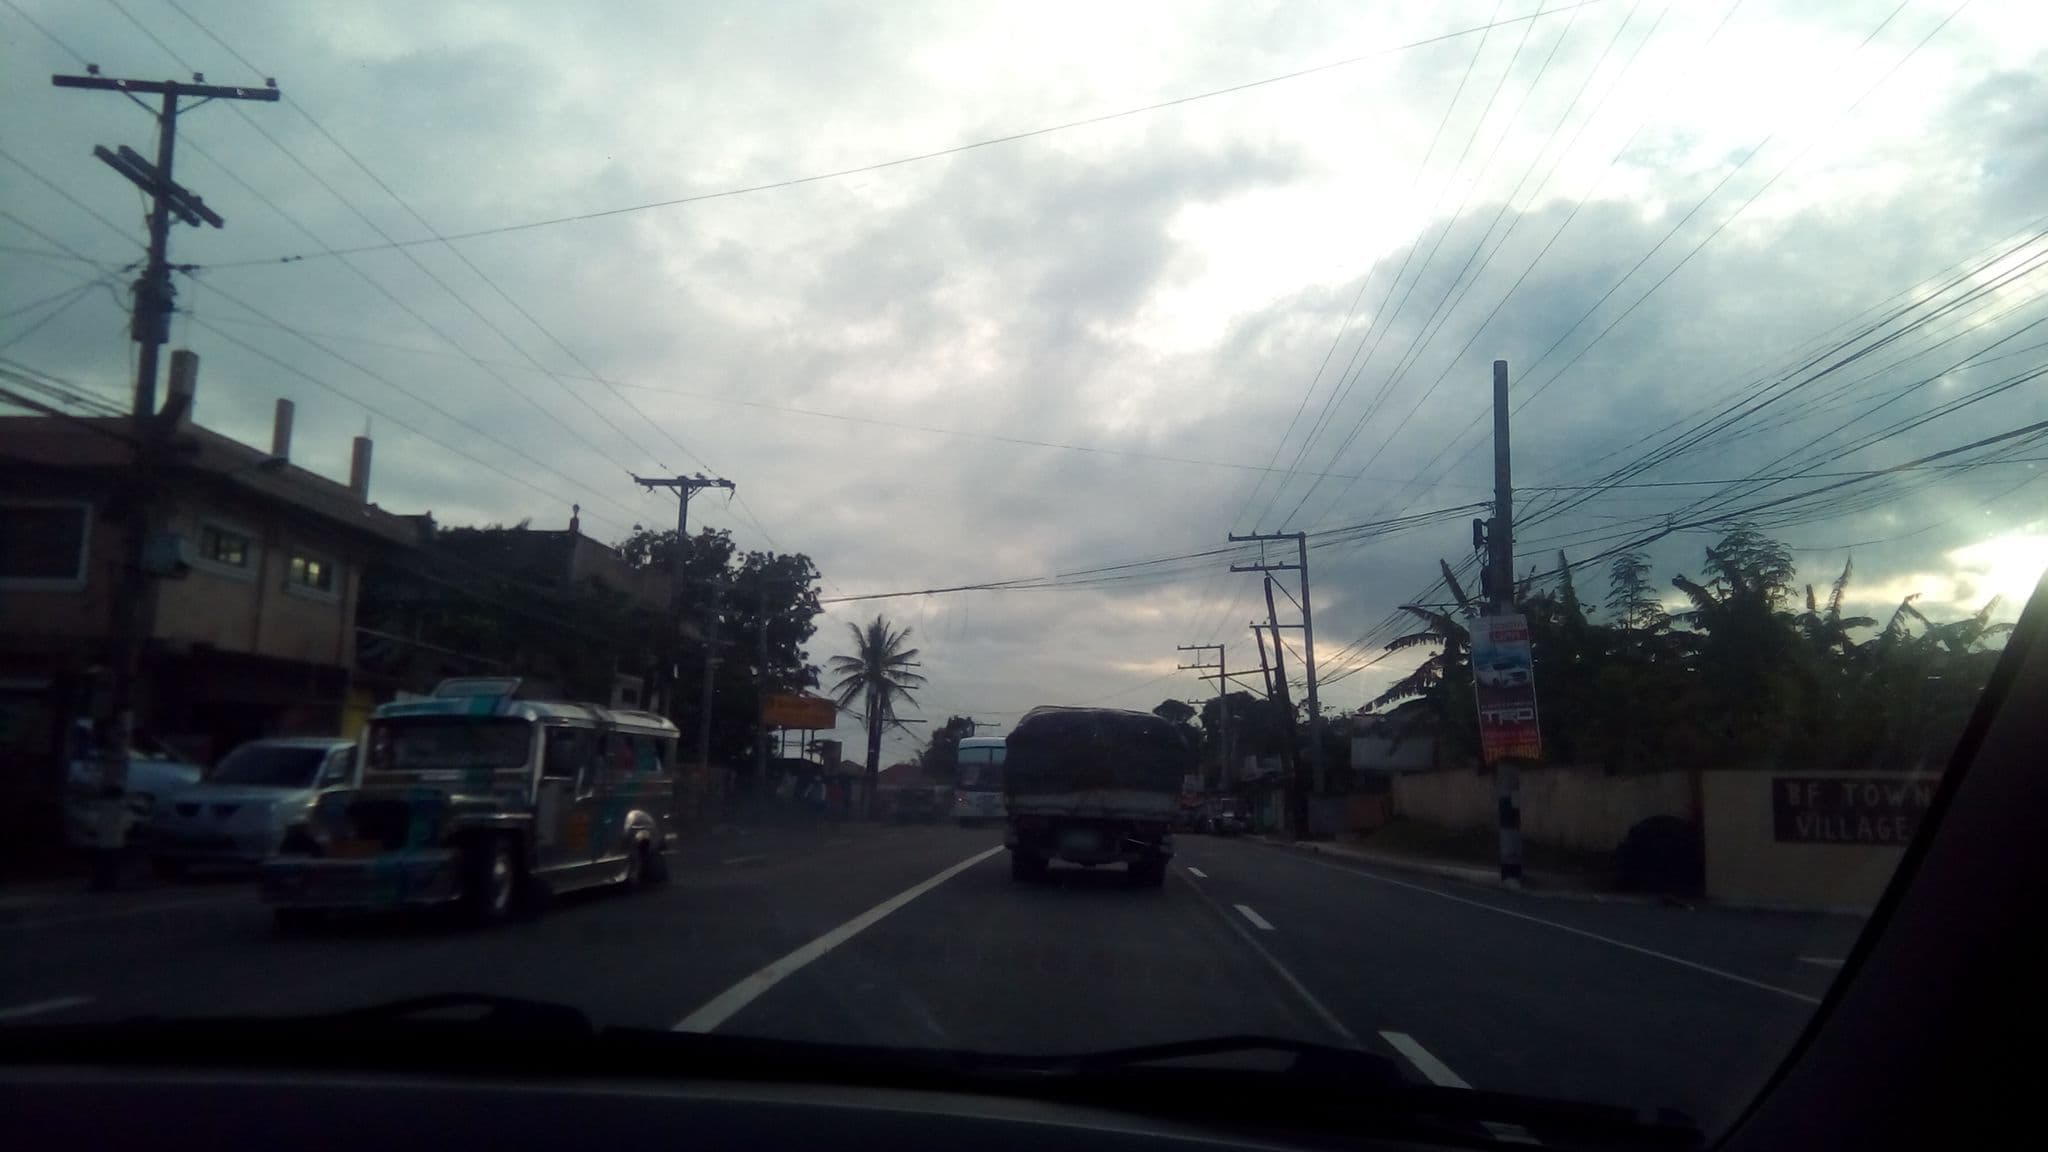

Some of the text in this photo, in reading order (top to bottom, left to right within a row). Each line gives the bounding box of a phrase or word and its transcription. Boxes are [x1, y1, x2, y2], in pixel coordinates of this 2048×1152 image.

[1481, 708, 1534, 726] TRD
[1841, 783, 1934, 808] TOWN
[1795, 815, 1910, 841] VILLAGE
